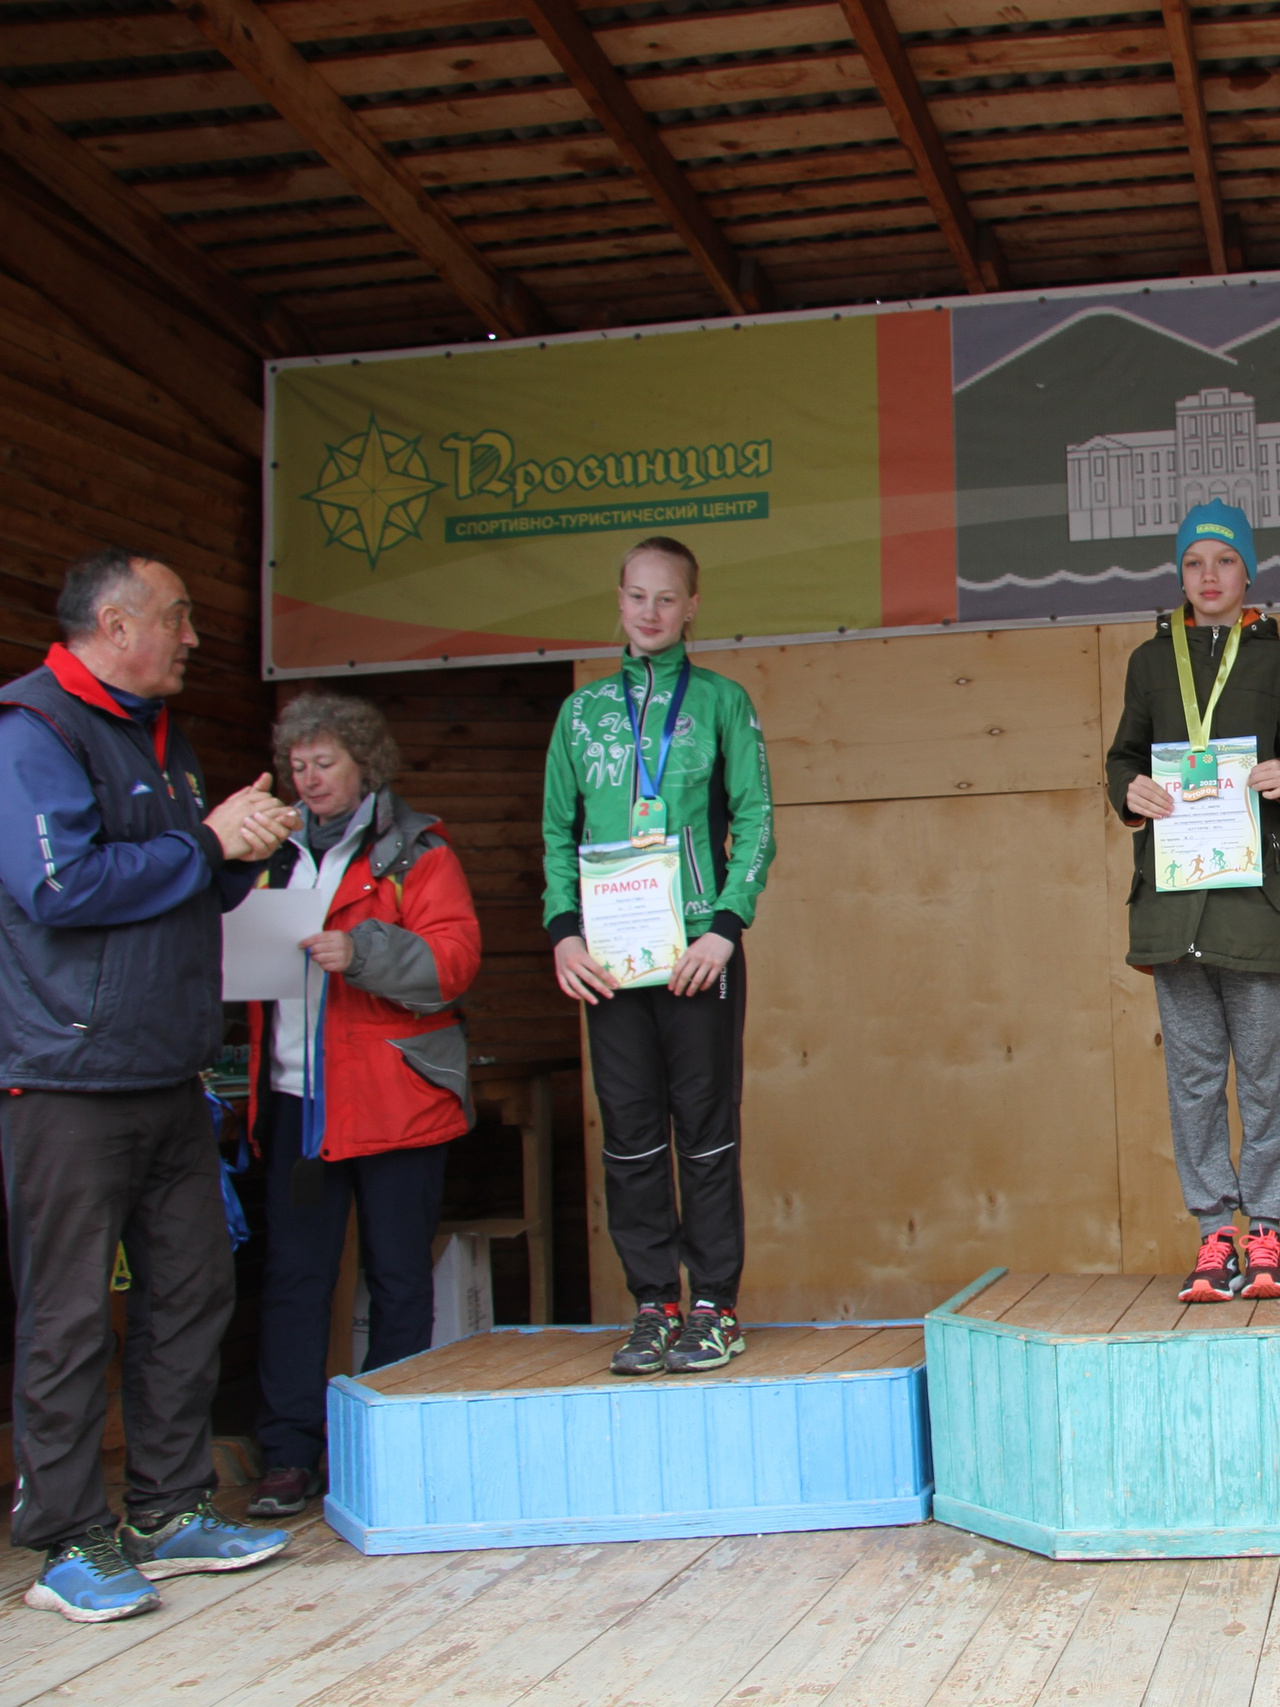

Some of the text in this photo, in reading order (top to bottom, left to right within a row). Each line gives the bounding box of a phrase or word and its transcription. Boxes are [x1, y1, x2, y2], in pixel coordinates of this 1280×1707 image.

[439, 428, 772, 508] Провинция
[454, 500, 759, 536] СПОРТИВНО-ТУРИСТИЧЕСКИЙ ЦЕНТР
[1187, 755, 1197, 769] 1
[1165, 777, 1234, 793] ГРТА
[1199, 779, 1217, 787] 2023
[638, 802, 650, 816] 2
[593, 877, 659, 896] ГРАМОТА
[719, 965, 727, 999] NORD
